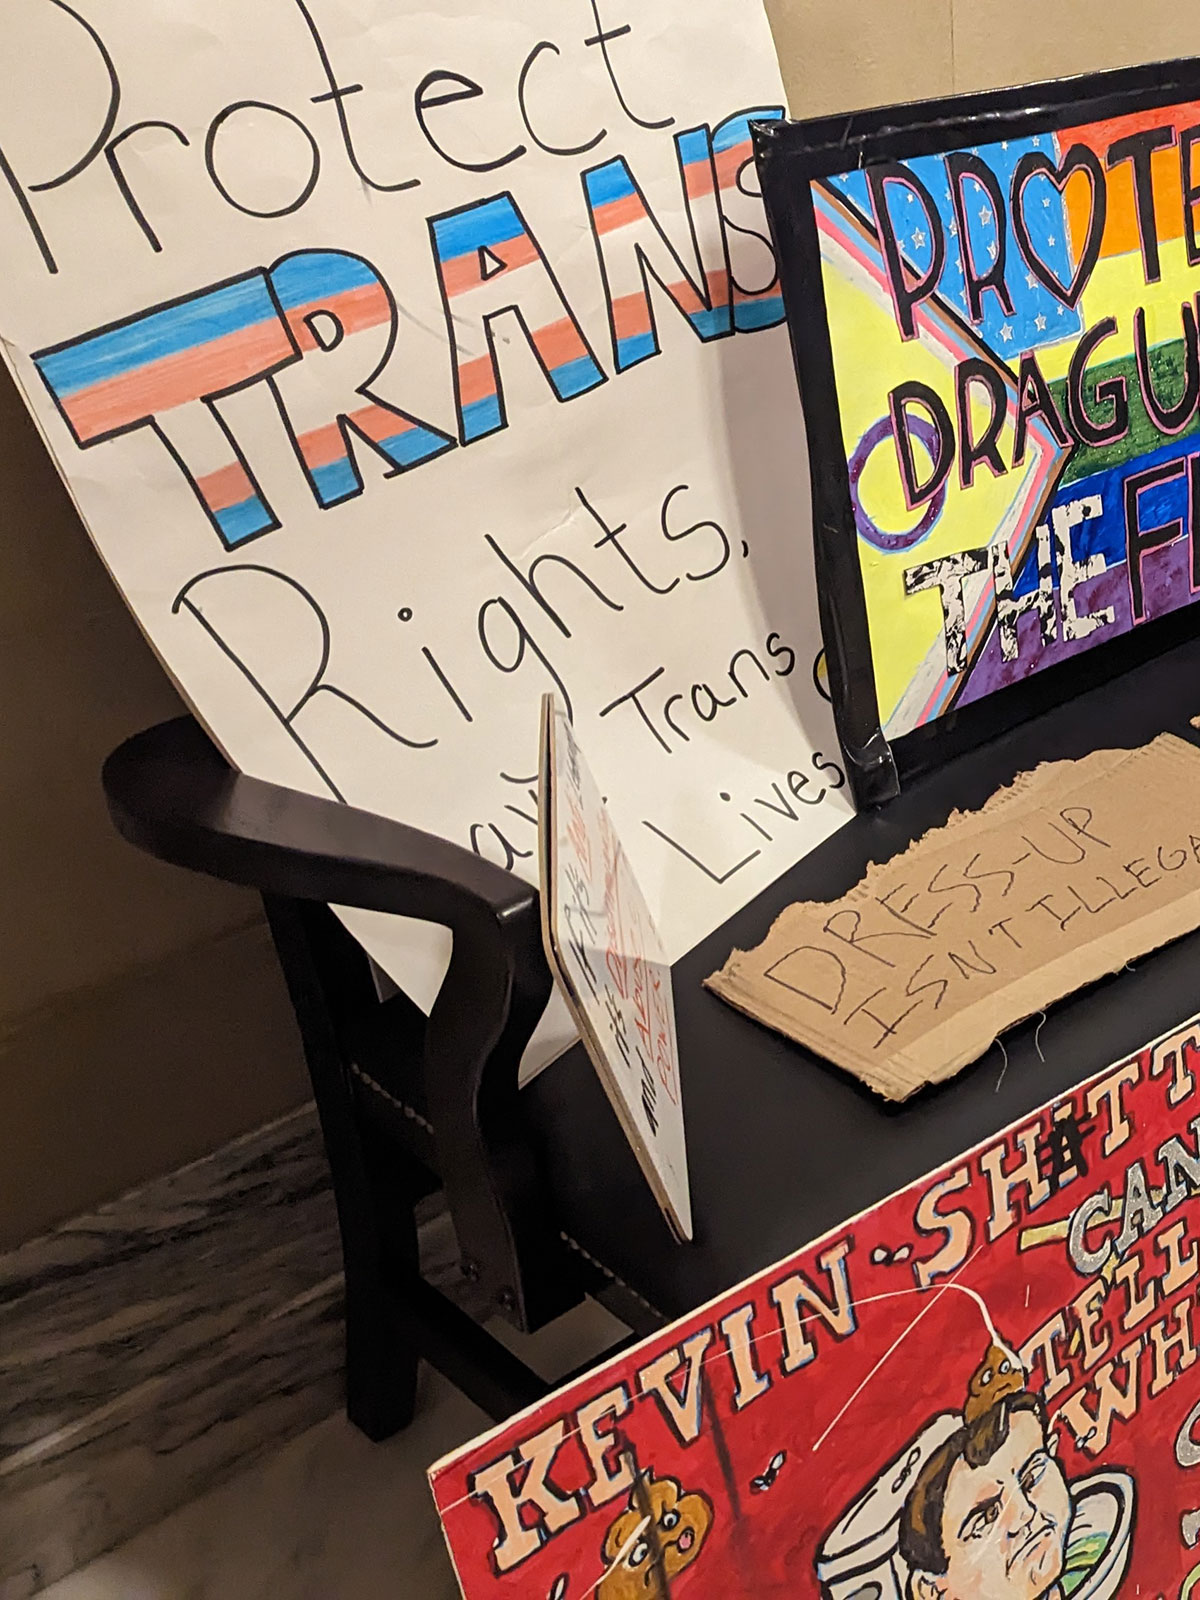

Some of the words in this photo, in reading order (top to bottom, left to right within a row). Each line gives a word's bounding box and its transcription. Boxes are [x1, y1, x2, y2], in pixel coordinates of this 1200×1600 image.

[0, 0, 675, 274] Protect
[31, 105, 792, 553] TRANS
[888, 315, 1130, 511] DRAG
[903, 494, 1115, 675] THE
[600, 632, 796, 754] Trans
[642, 752, 847, 884] Lives
[763, 806, 1111, 1015] DRESS-UP
[468, 1233, 858, 1578] KEVIN
[1018, 1216, 1200, 1402] TELL
